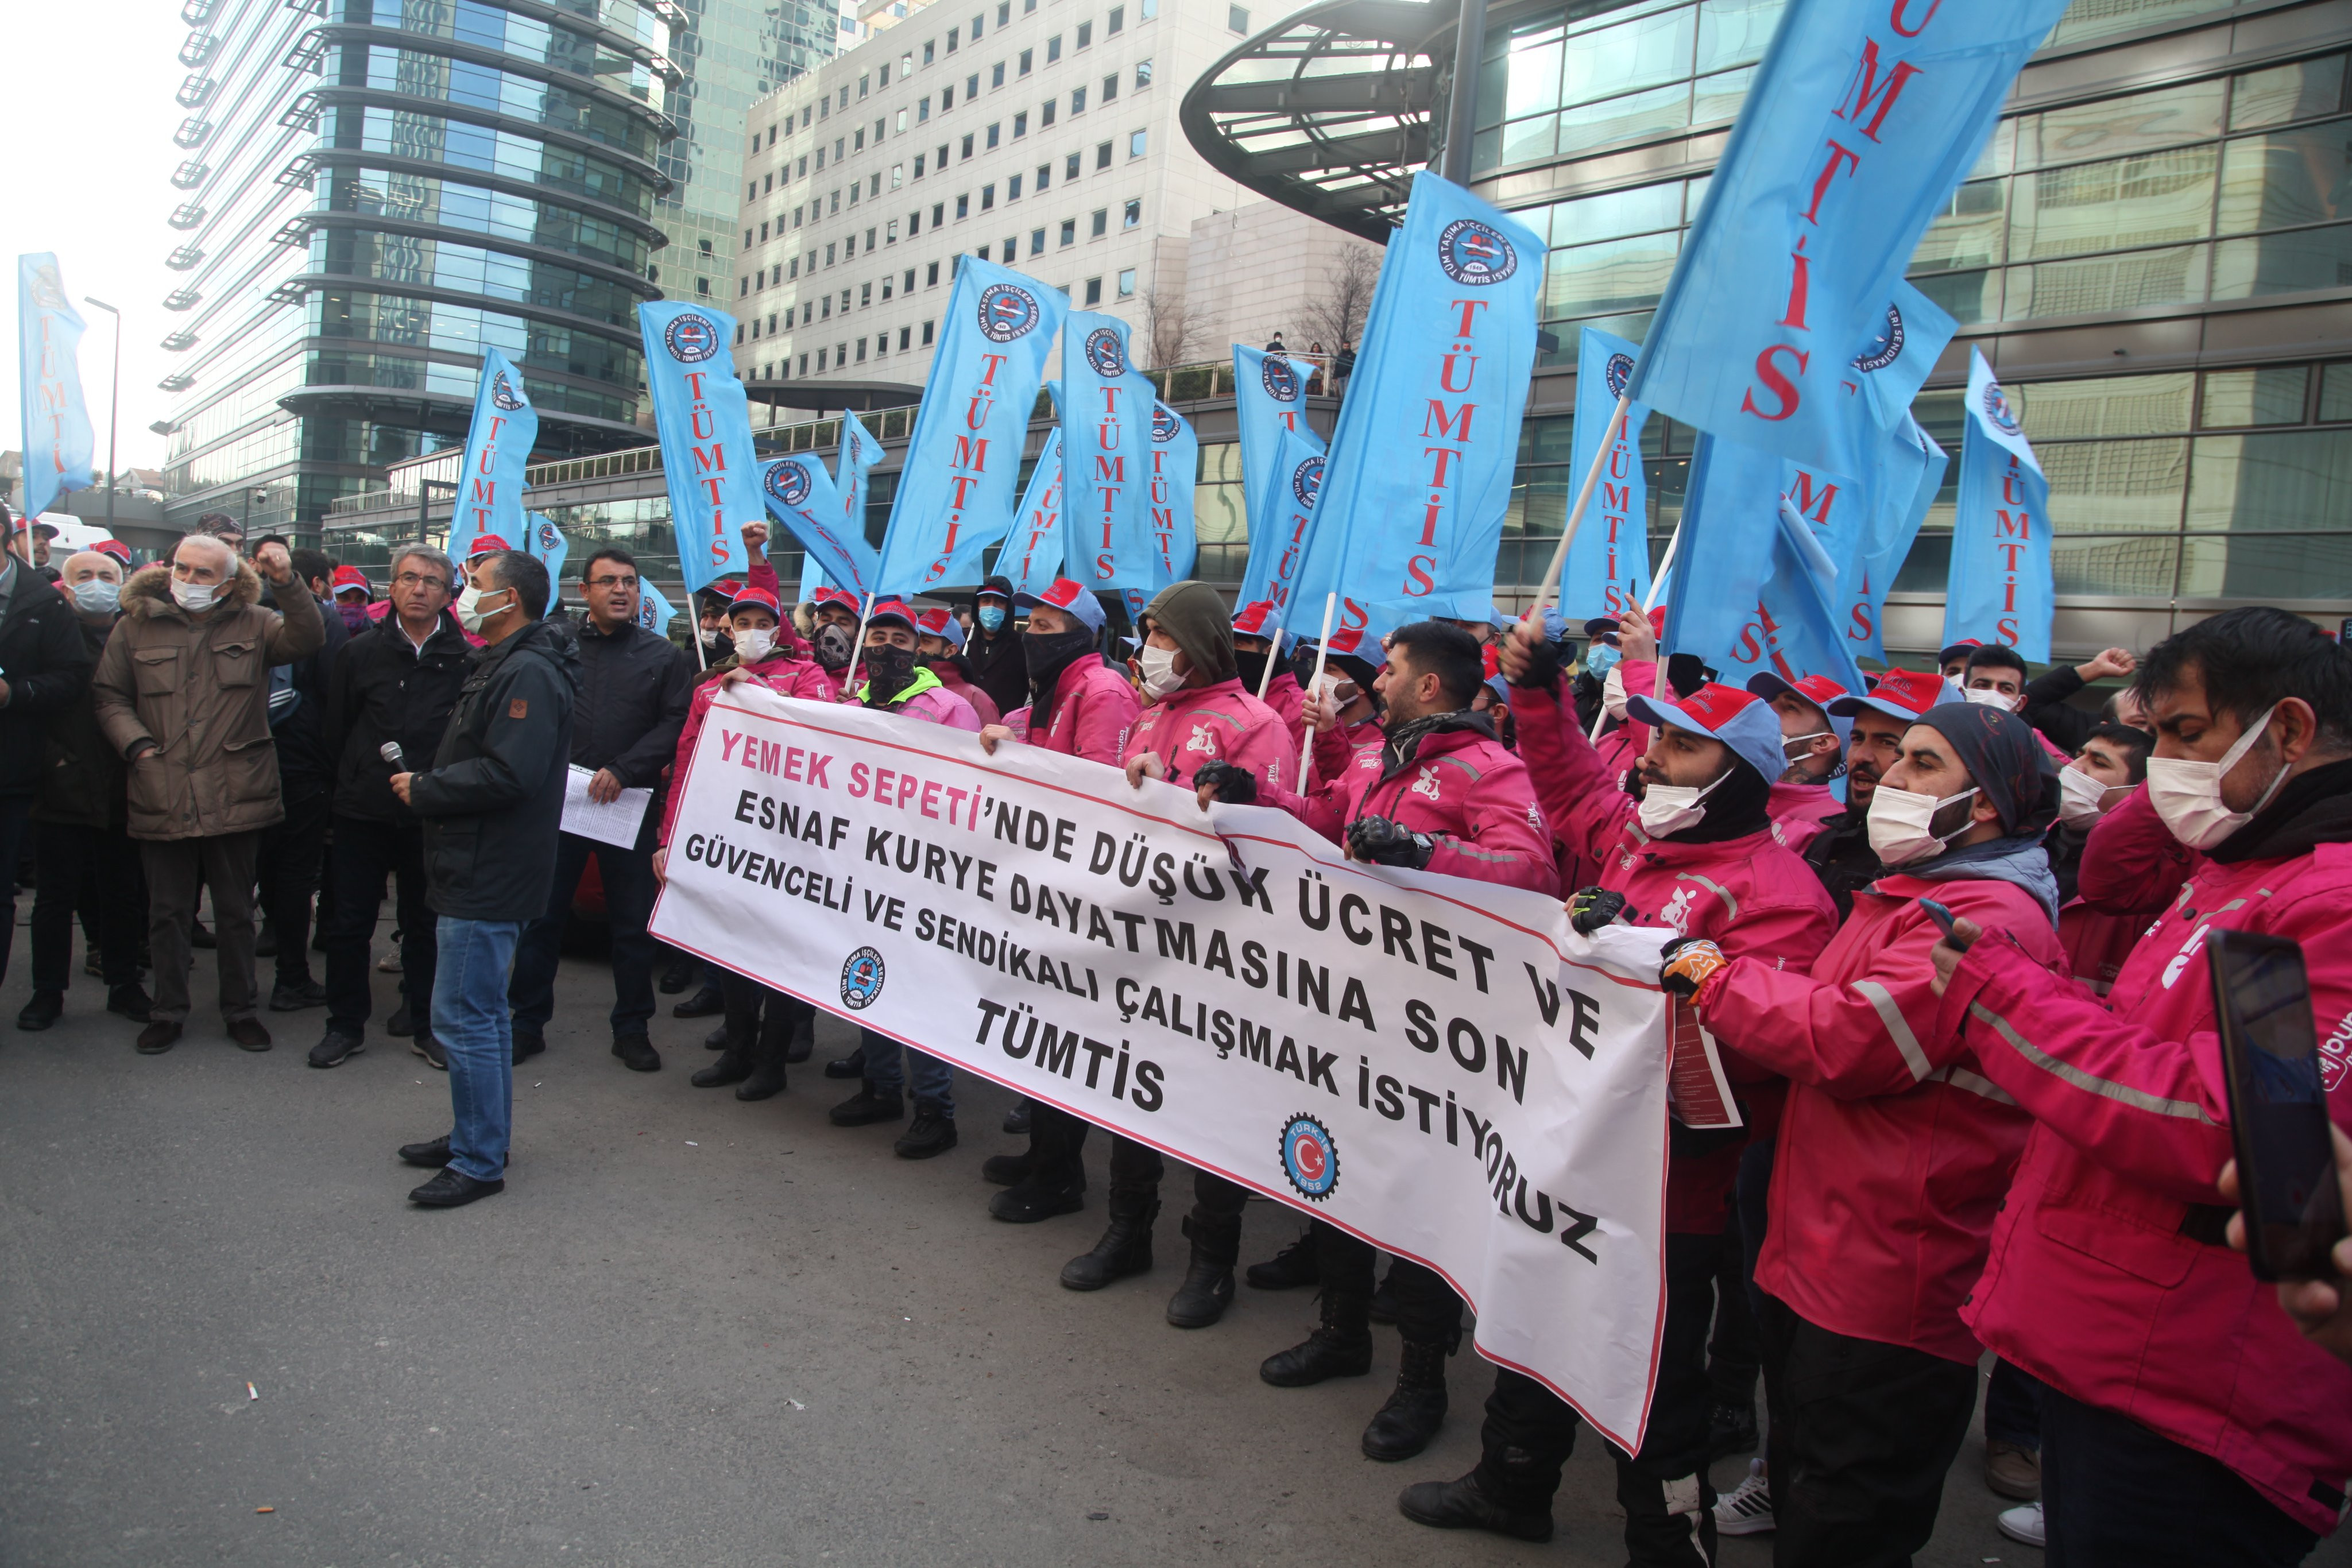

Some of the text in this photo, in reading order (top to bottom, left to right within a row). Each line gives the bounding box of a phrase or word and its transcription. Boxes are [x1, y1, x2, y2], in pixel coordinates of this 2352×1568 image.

[1440, 222, 1465, 252] TAŞIMA
[1464, 220, 1506, 245] İŞÇİLERİ
[1441, 255, 1457, 277] TÜM
[1459, 273, 1491, 284] TÜMTİS
[980, 287, 1000, 313] TAŞIMA
[1001, 284, 1035, 304] İŞÇİLERİ
[667, 320, 679, 345] TAŞIMA
[679, 314, 710, 327] İŞÇİLERİ
[980, 317, 990, 334] TÜM
[990, 331, 1011, 341] TÜMTİS
[1863, 329, 1903, 370] SENDİKASI
[670, 346, 680, 359] TÜM
[1402, 299, 1488, 597] TÜMTİS
[684, 372, 730, 567] TÜMTİS
[926, 353, 1007, 583] TÜMTİS
[1294, 459, 1315, 497] TÜM TAŞIMA
[1093, 386, 1126, 580] TÜMTİS
[721, 729, 1600, 1060] YEMEK SEPETİ'NDE DÜŞÜK ÜCRET VE
[734, 789, 850, 851] ESNAF
[865, 826, 998, 902] KURYE
[1011, 873, 1377, 1033] DAYATMASINA
[1404, 998, 1529, 1106] SON
[862, 948, 882, 965] İŞÇİLERİ
[843, 952, 861, 976] TAŞIMA
[865, 967, 884, 1005] SENDİKASI
[685, 833, 853, 914] GÜVENCELİ
[864, 889, 906, 932] VE
[915, 908, 1099, 1002] SENDİKALI
[1115, 977, 1340, 1097] ÇALIŞMAK
[1357, 1055, 1599, 1267] İSTİYORUZ
[976, 998, 1165, 1113] TÜMTİS
[1290, 1122, 1330, 1154] TÜRK-İŞ
[1295, 1172, 1322, 1191] 1952
